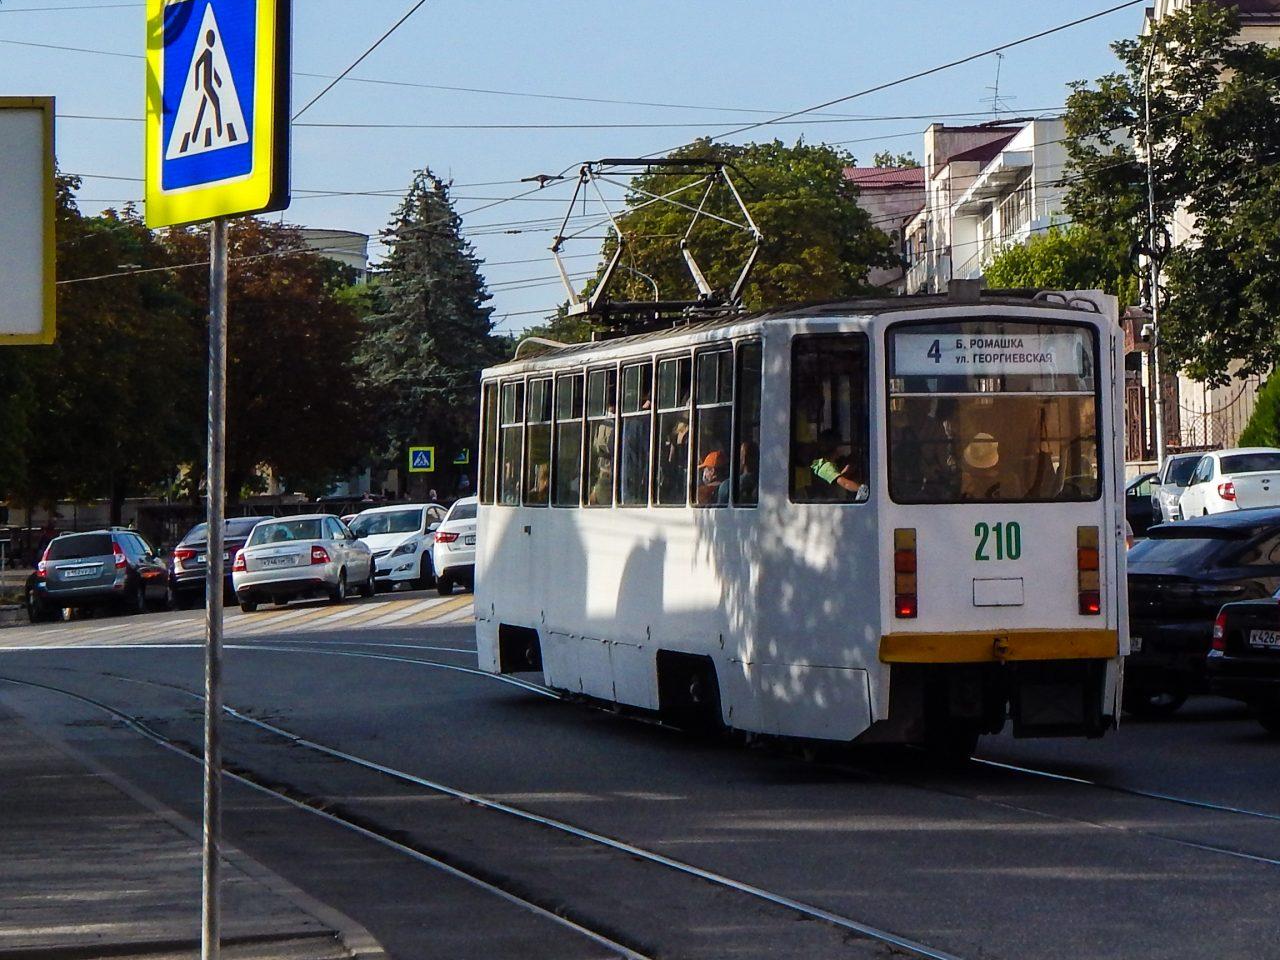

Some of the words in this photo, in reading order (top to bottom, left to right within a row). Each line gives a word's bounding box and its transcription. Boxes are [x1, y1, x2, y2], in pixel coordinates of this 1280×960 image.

[926, 339, 942, 364] 4
[955, 339, 967, 349] Б.
[969, 339, 1024, 349] РОМАШКА
[955, 353, 970, 364] ул.
[972, 353, 1053, 364] ГЕОРГИЕВСКАЯ
[974, 521, 1021, 561] 210
